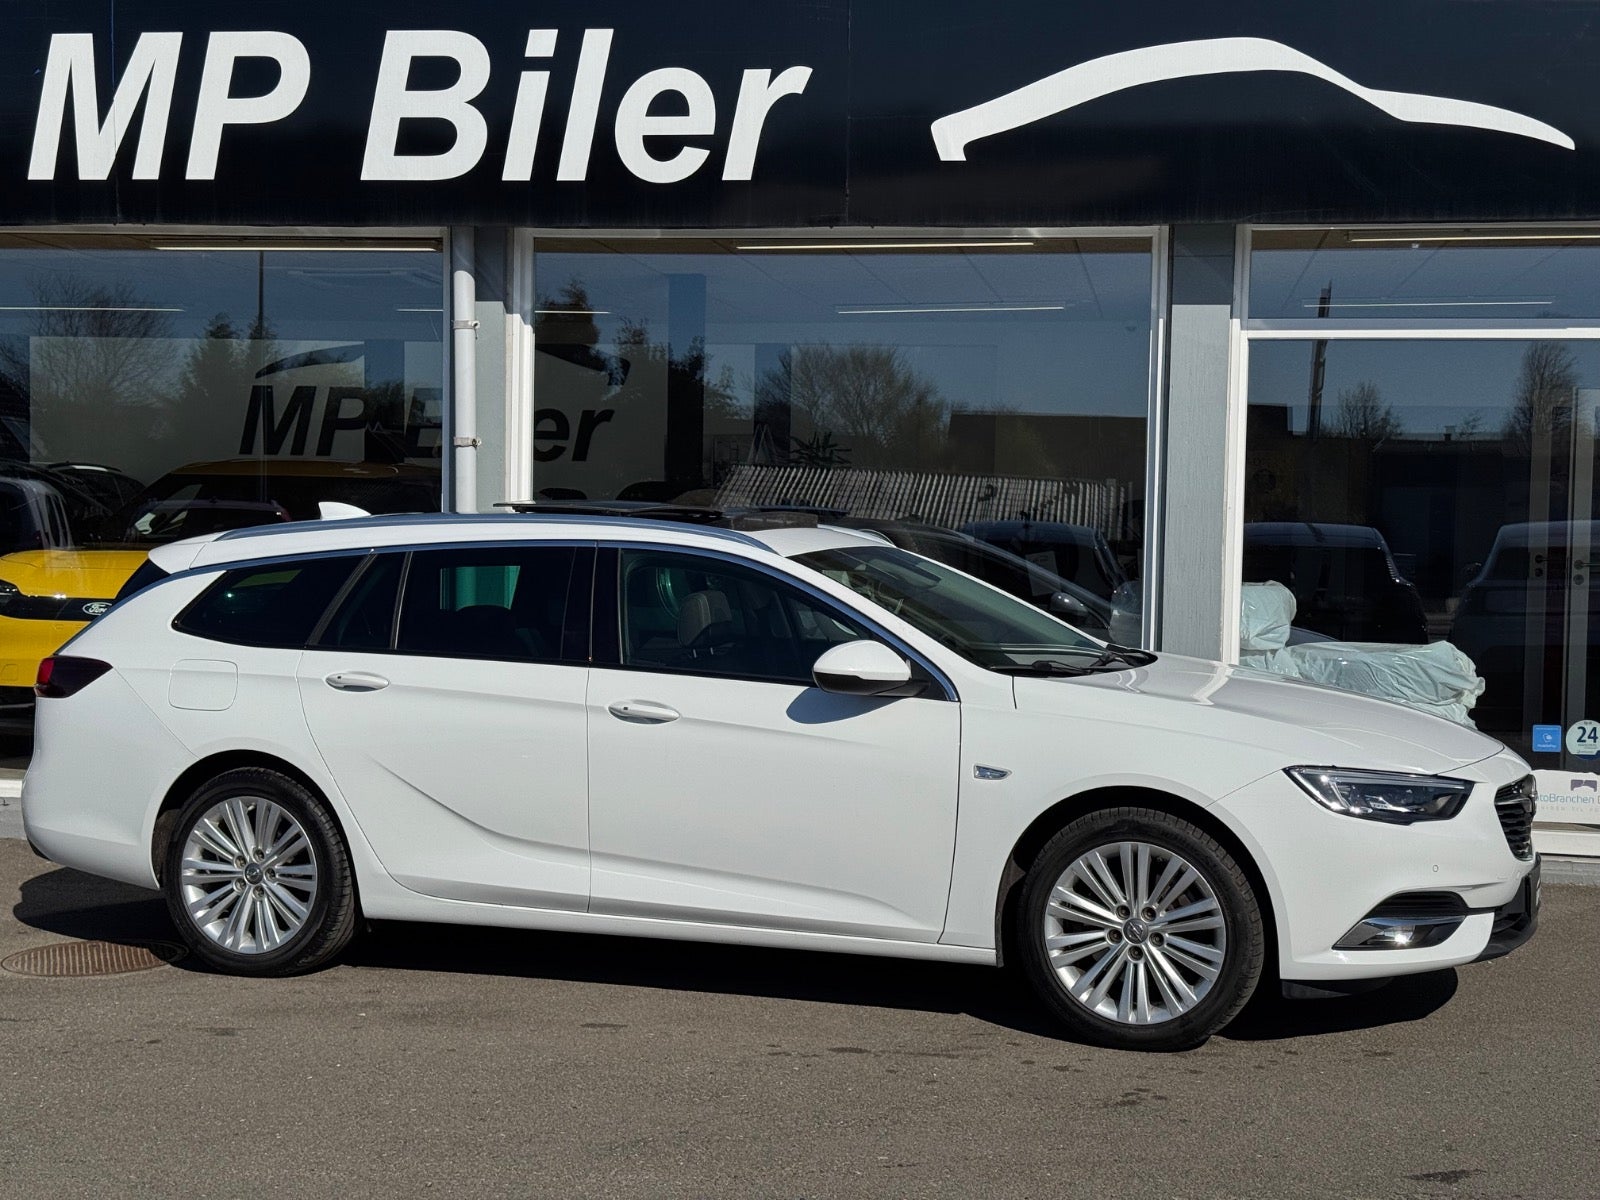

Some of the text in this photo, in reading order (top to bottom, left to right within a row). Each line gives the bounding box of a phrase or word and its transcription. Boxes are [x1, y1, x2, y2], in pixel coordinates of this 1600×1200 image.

[28, 29, 812, 183] MP Biler
[238, 386, 371, 457] MP
[1577, 726, 1598, 743] 24
